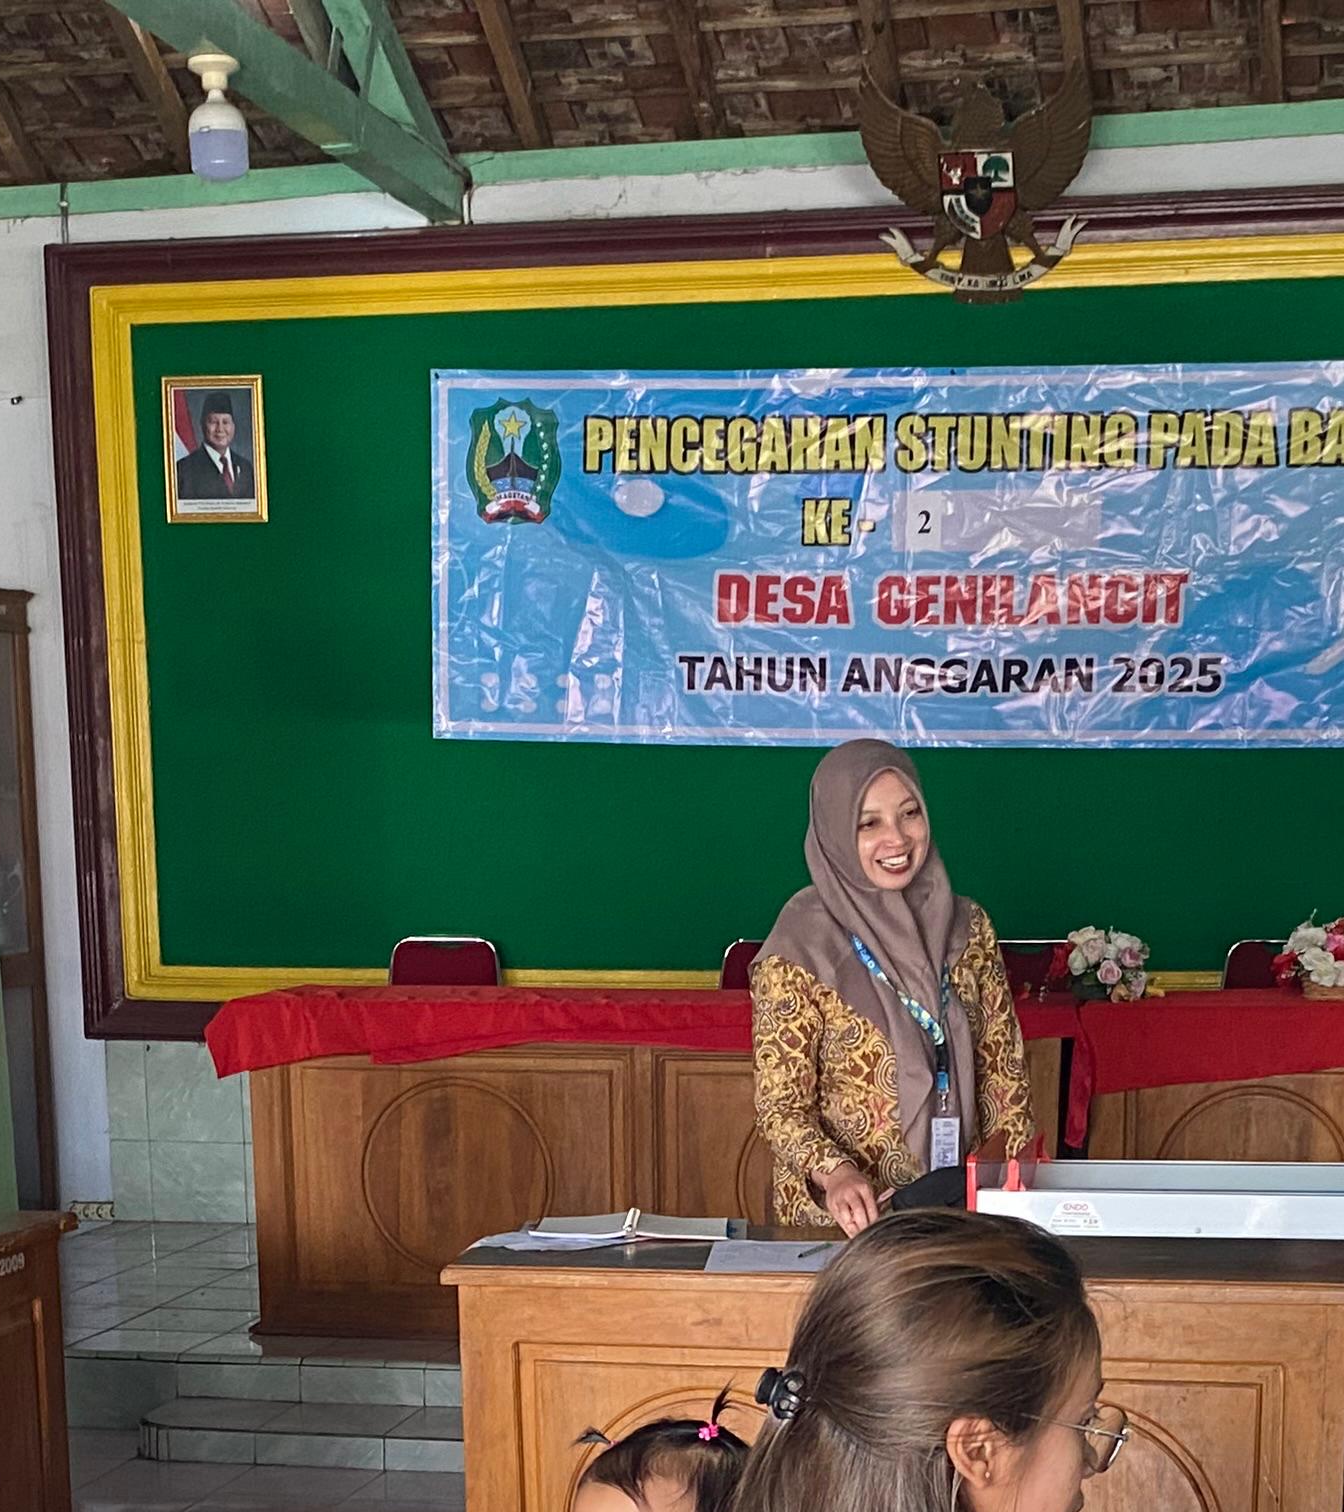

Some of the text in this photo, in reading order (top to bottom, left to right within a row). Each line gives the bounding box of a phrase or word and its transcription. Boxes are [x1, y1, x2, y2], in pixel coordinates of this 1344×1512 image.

[584, 414, 887, 474] PENCEGAHAN
[896, 411, 1137, 474] STUNTING
[1148, 409, 1275, 468] PADA
[918, 510, 932, 534] 2
[717, 572, 1189, 625] DESA GENILANGIT
[678, 655, 1223, 694] TAHUN ANGGARAN 2025
